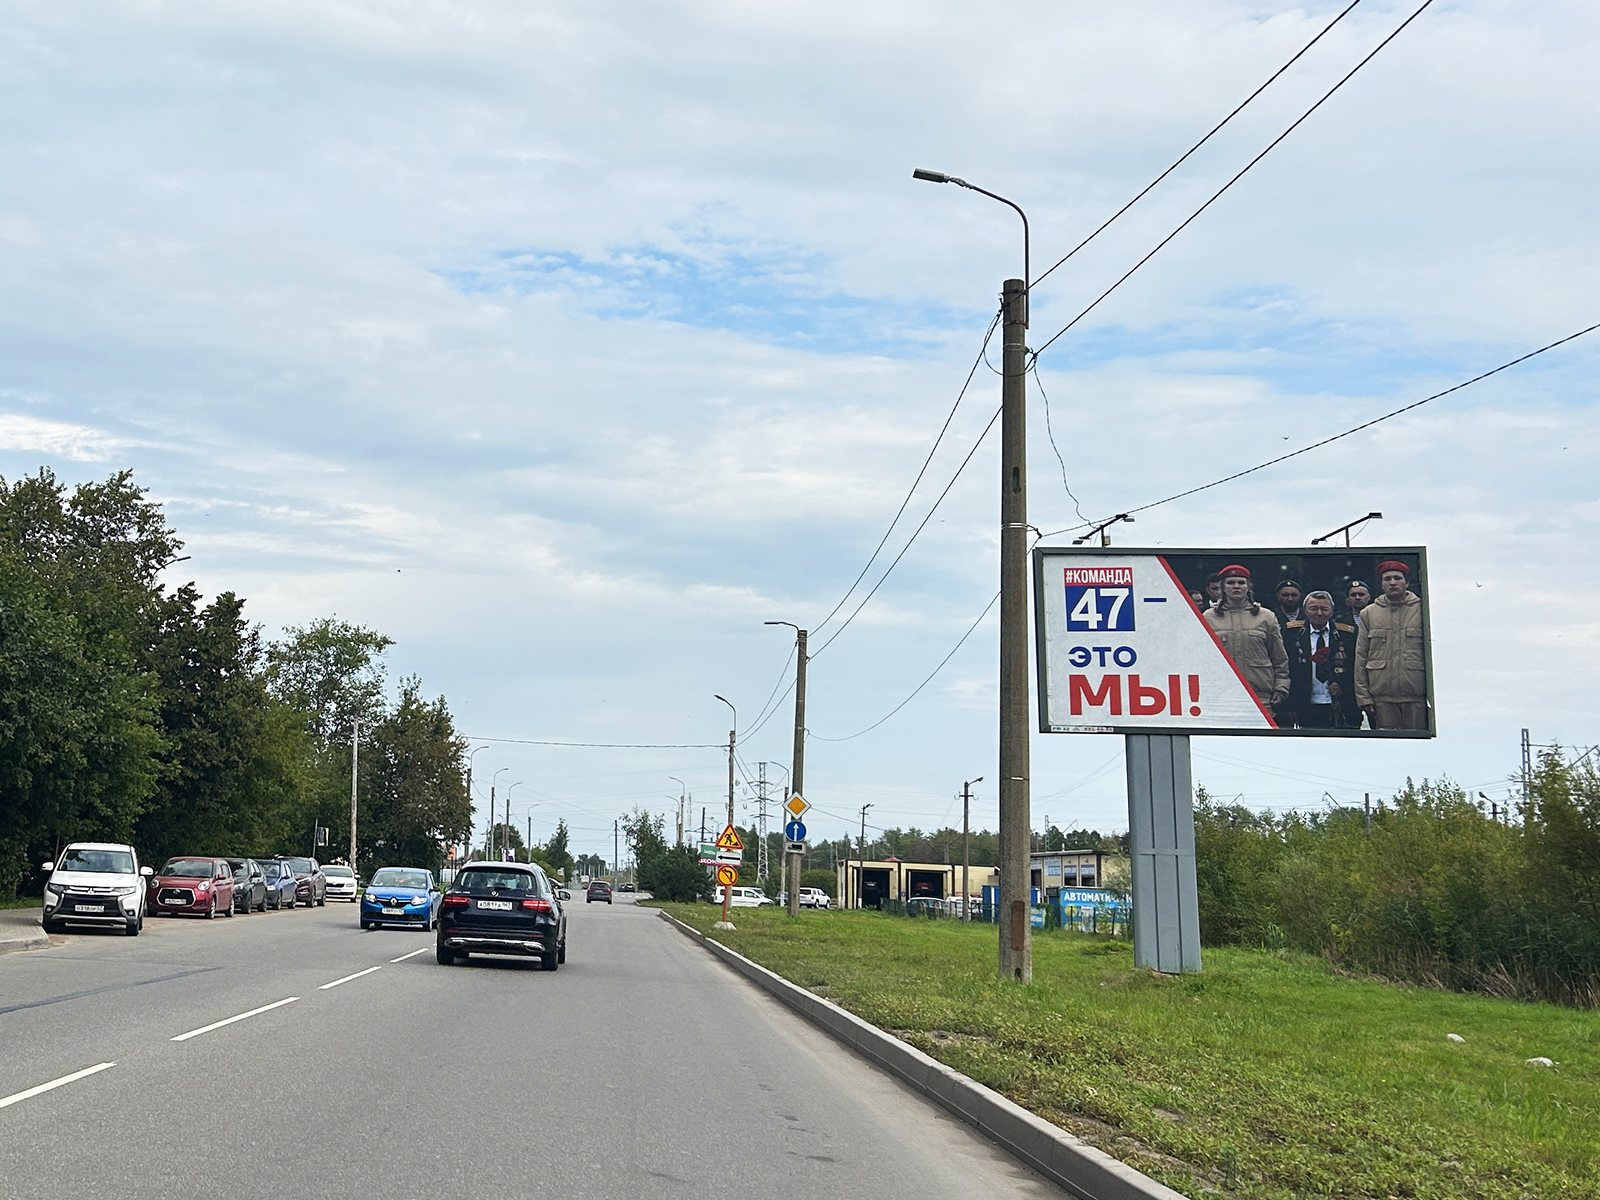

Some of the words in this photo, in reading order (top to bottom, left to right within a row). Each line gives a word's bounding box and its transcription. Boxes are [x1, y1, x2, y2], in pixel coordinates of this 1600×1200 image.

[1066, 569, 1132, 585] #КОМАНДА
[1070, 588, 1130, 630] 47
[1068, 646, 1137, 668] ЭТО
[1068, 674, 1202, 717] МЫ!
